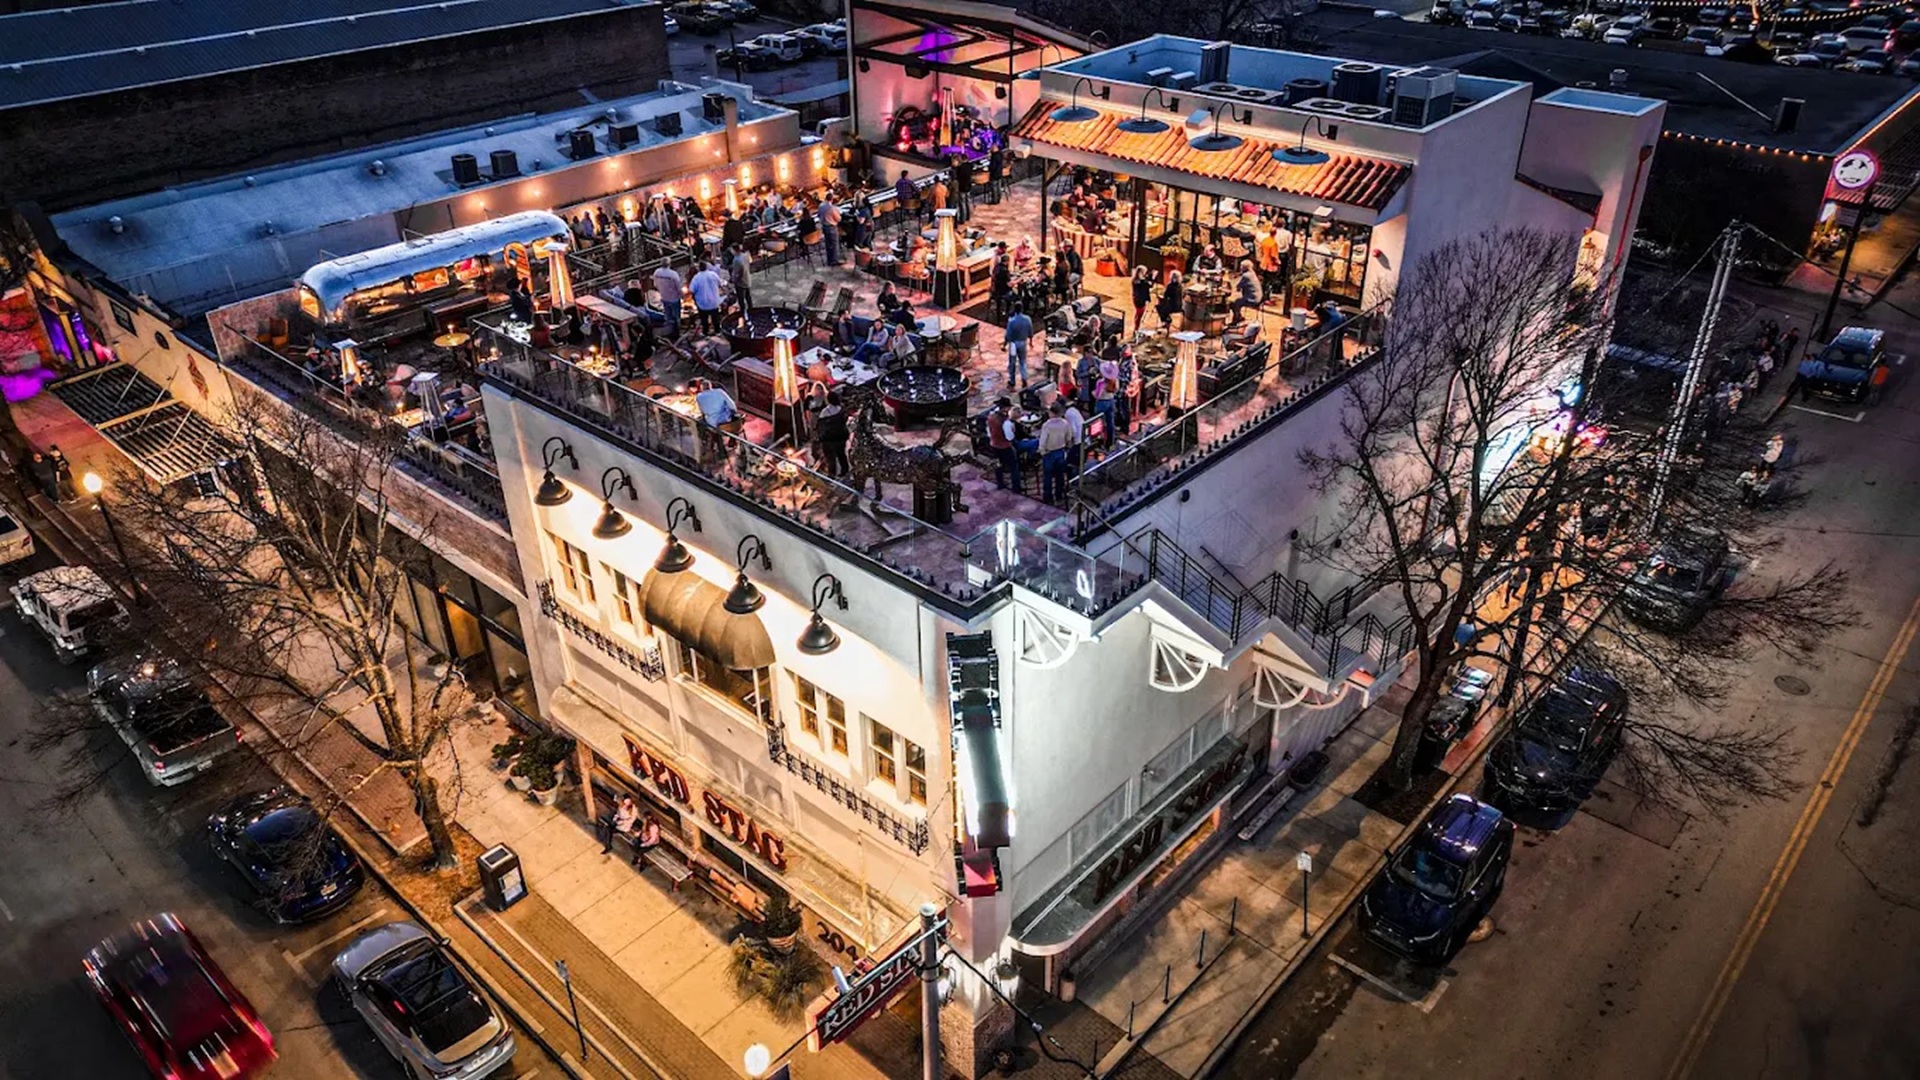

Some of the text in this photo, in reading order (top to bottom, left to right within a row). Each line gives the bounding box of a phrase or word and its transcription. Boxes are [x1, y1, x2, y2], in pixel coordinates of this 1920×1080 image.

[621, 732, 788, 870] RED STAG
[816, 921, 859, 961] 204
[823, 946, 921, 1039] RED STA
